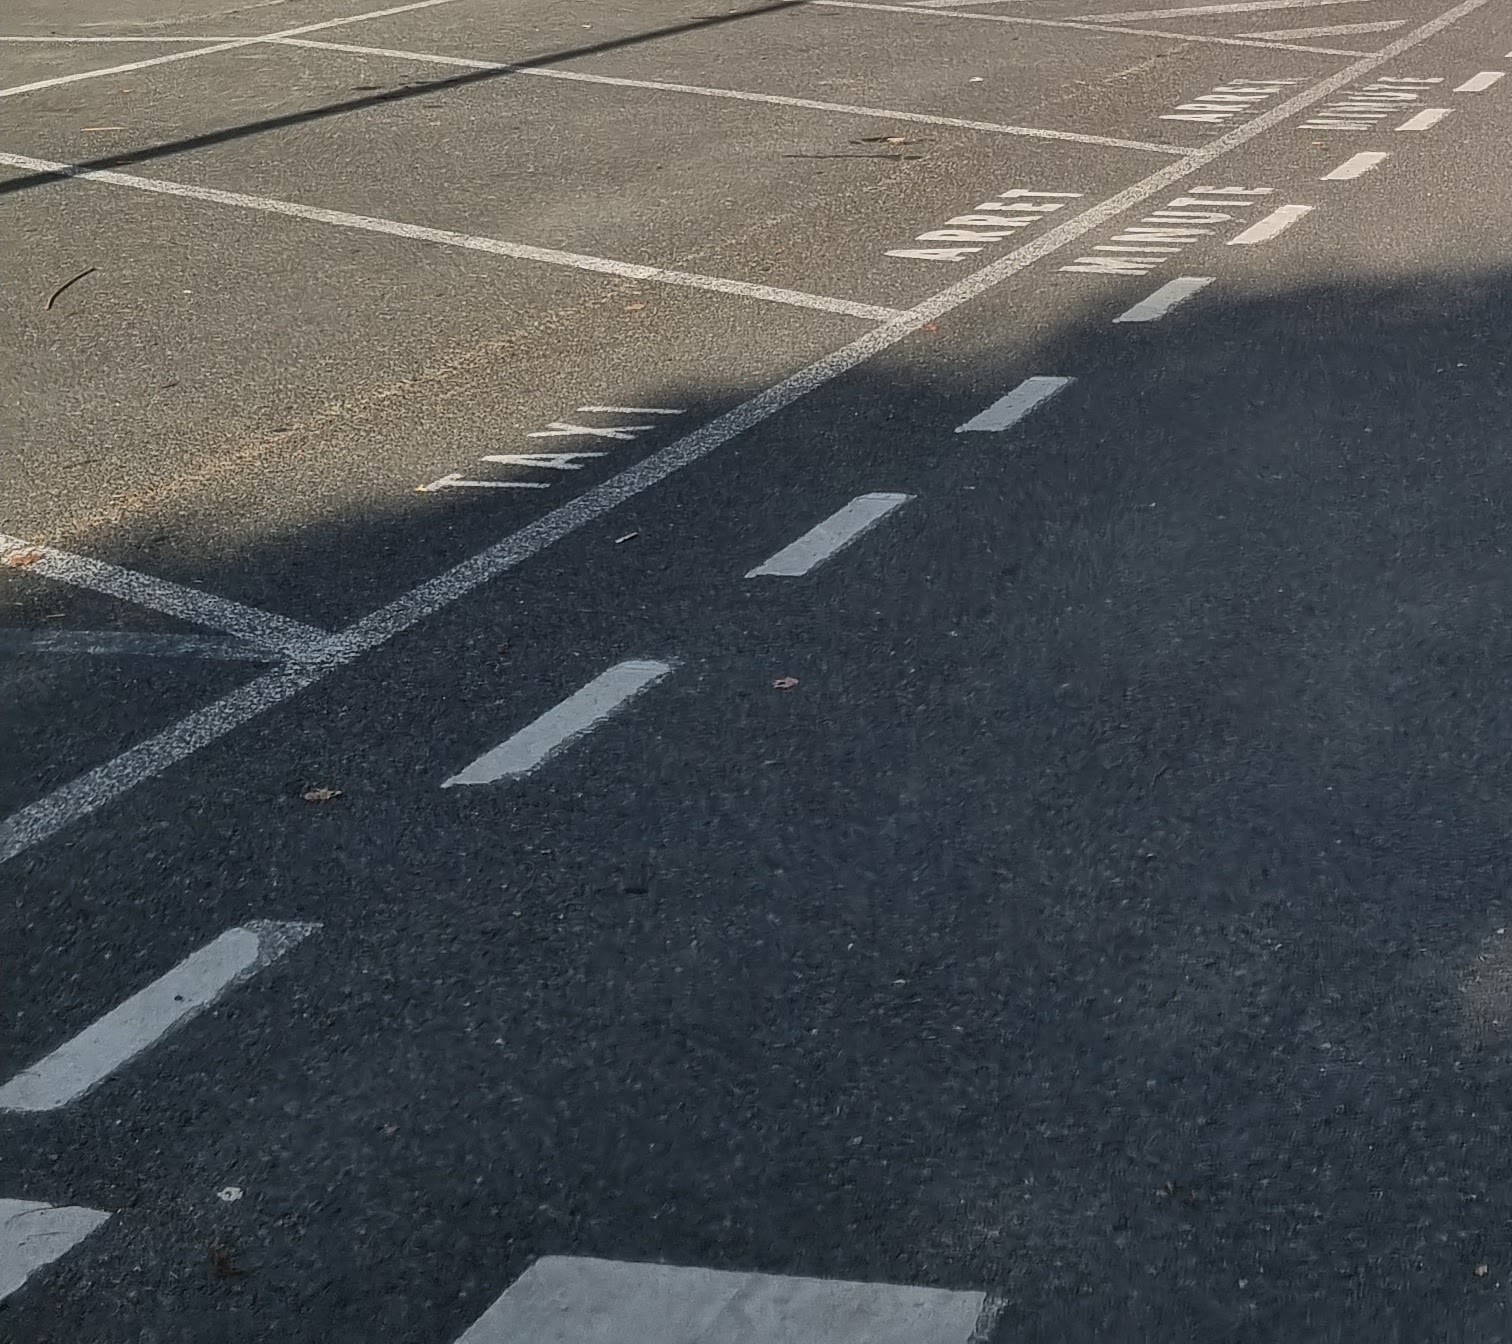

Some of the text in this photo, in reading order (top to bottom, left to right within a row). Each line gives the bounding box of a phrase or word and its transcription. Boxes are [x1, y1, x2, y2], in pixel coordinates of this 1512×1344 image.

[1158, 77, 1300, 124] ARRET
[1298, 77, 1445, 130] MINUTE
[883, 188, 1085, 262] ARRET
[1058, 185, 1276, 276] MINUTE
[420, 405, 688, 492] TAXI
